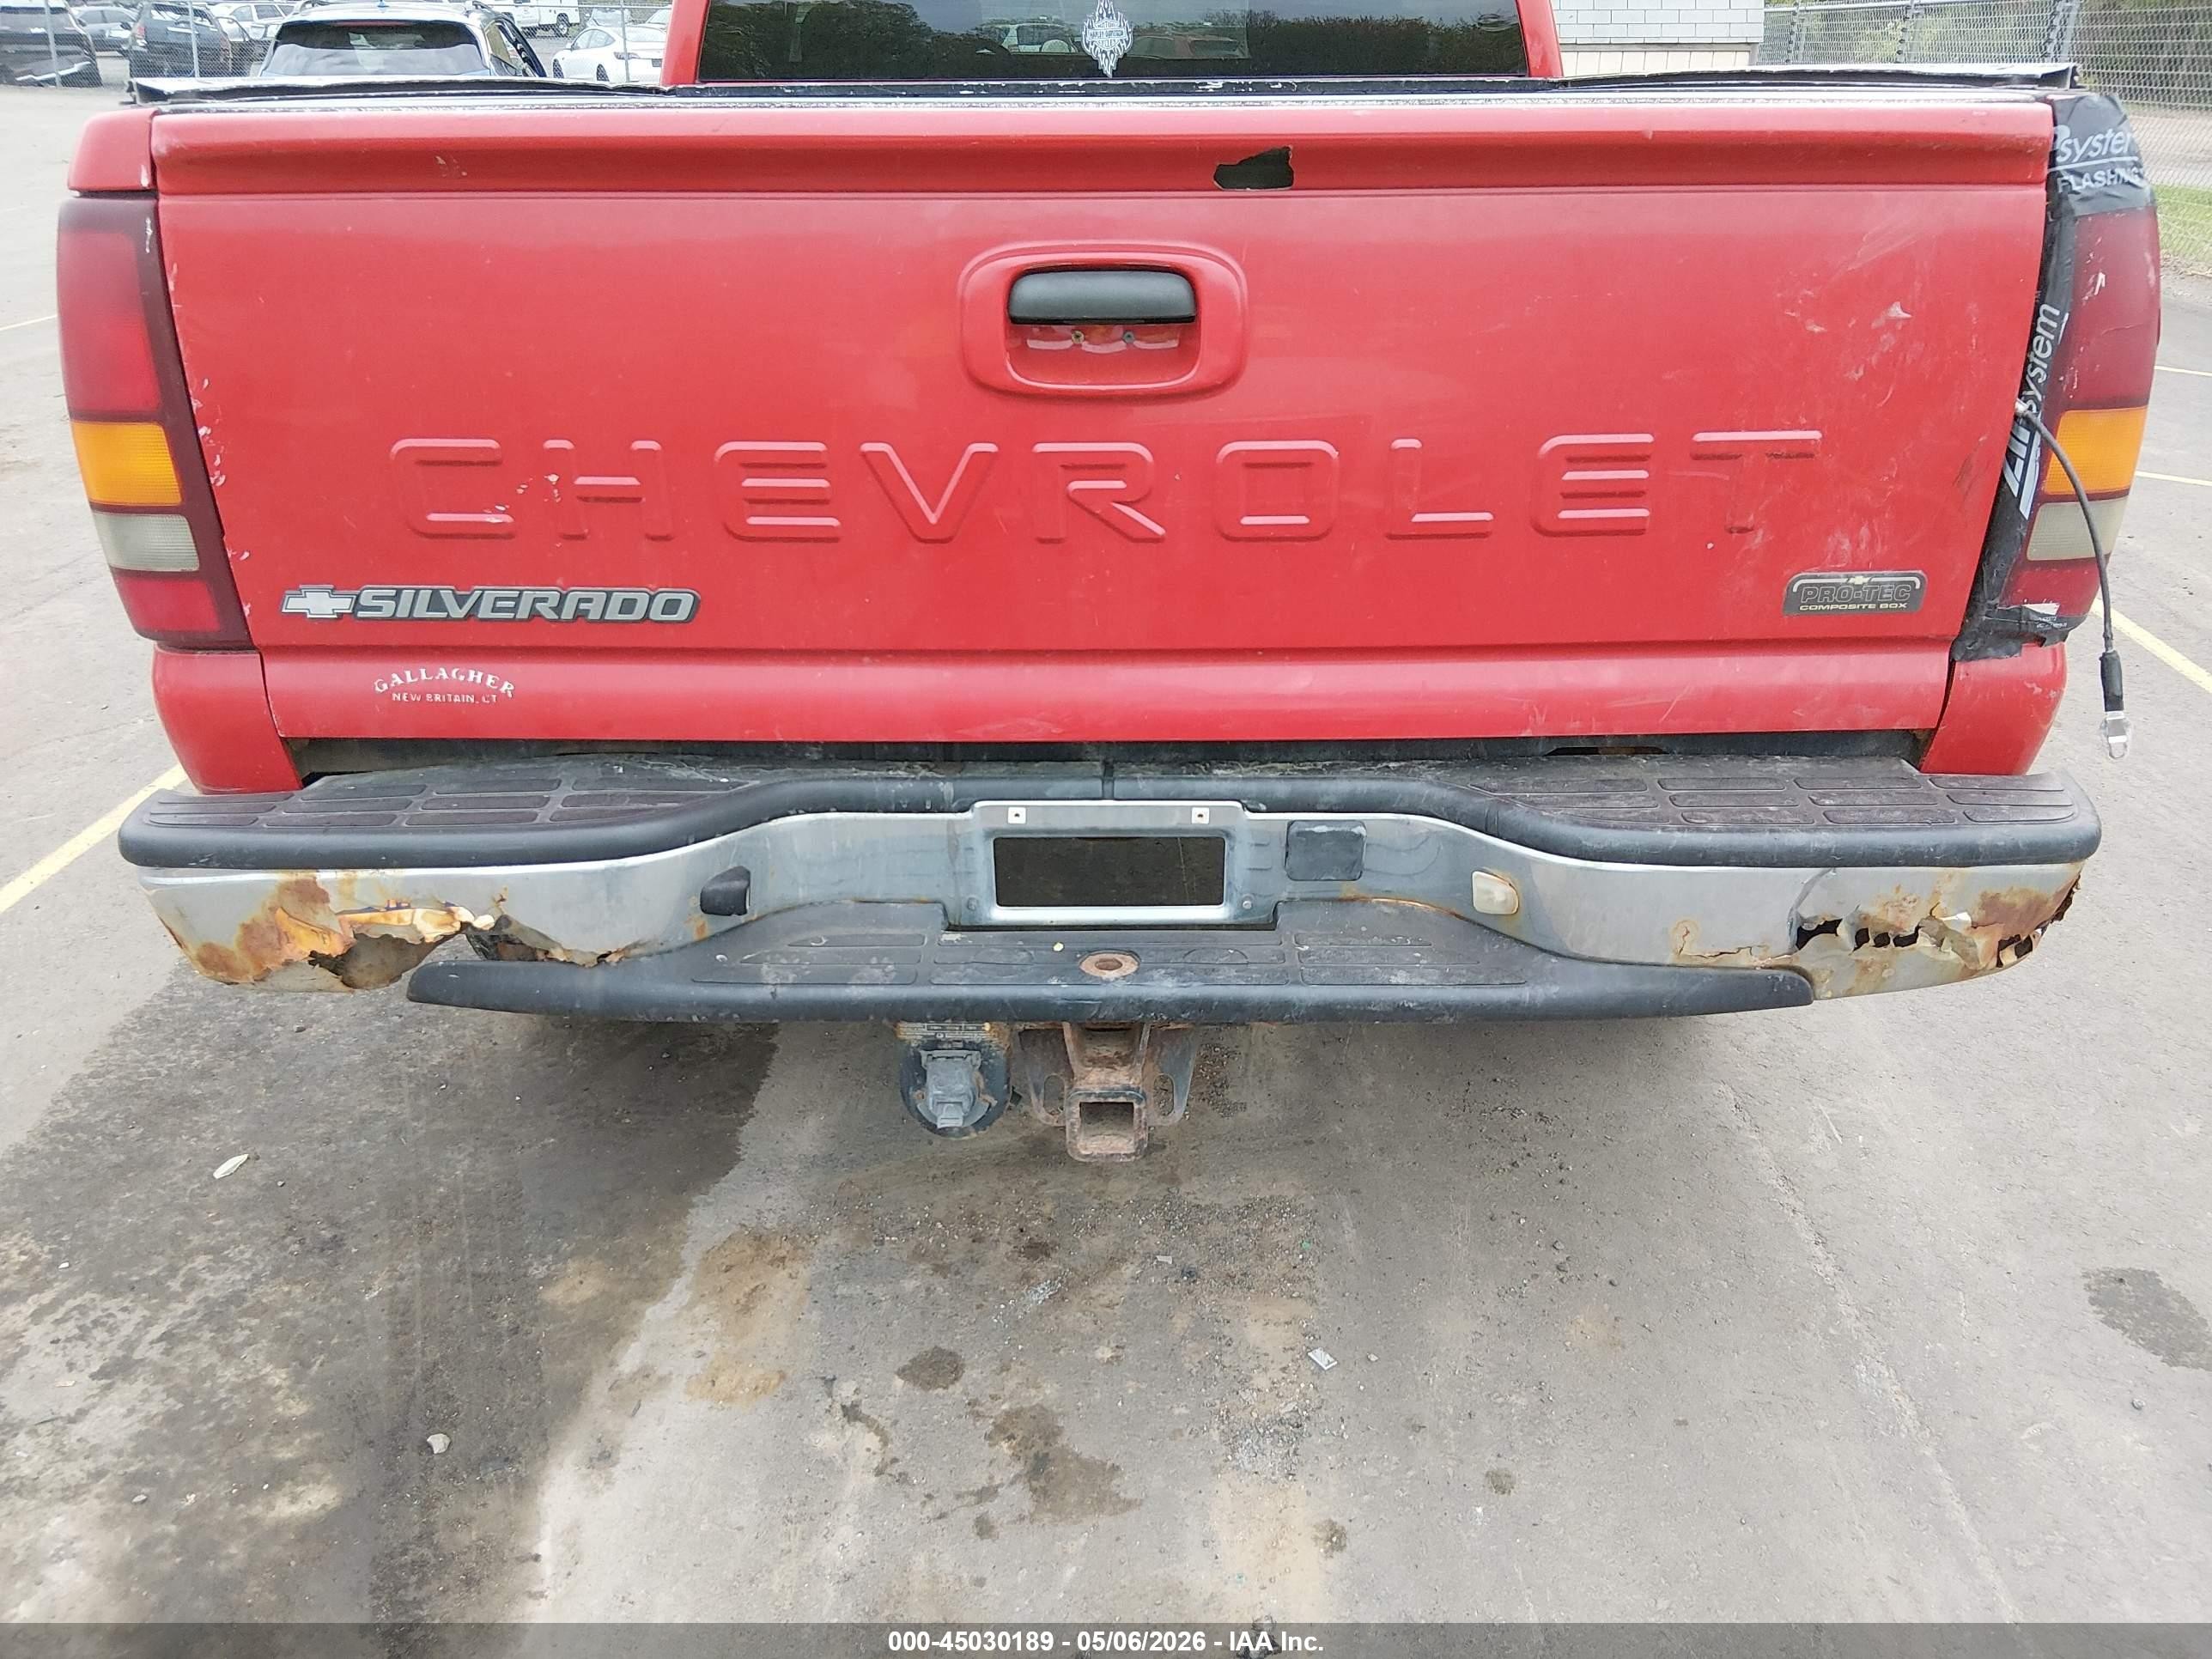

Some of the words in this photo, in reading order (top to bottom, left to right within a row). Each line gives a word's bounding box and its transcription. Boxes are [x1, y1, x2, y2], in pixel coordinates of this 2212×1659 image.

[388, 430, 1824, 546] CHEVROLET
[356, 588, 696, 623] SILVERADO
[374, 667, 514, 698] GALLAGHER
[392, 693, 421, 702] NEW
[482, 694, 497, 703] CT
